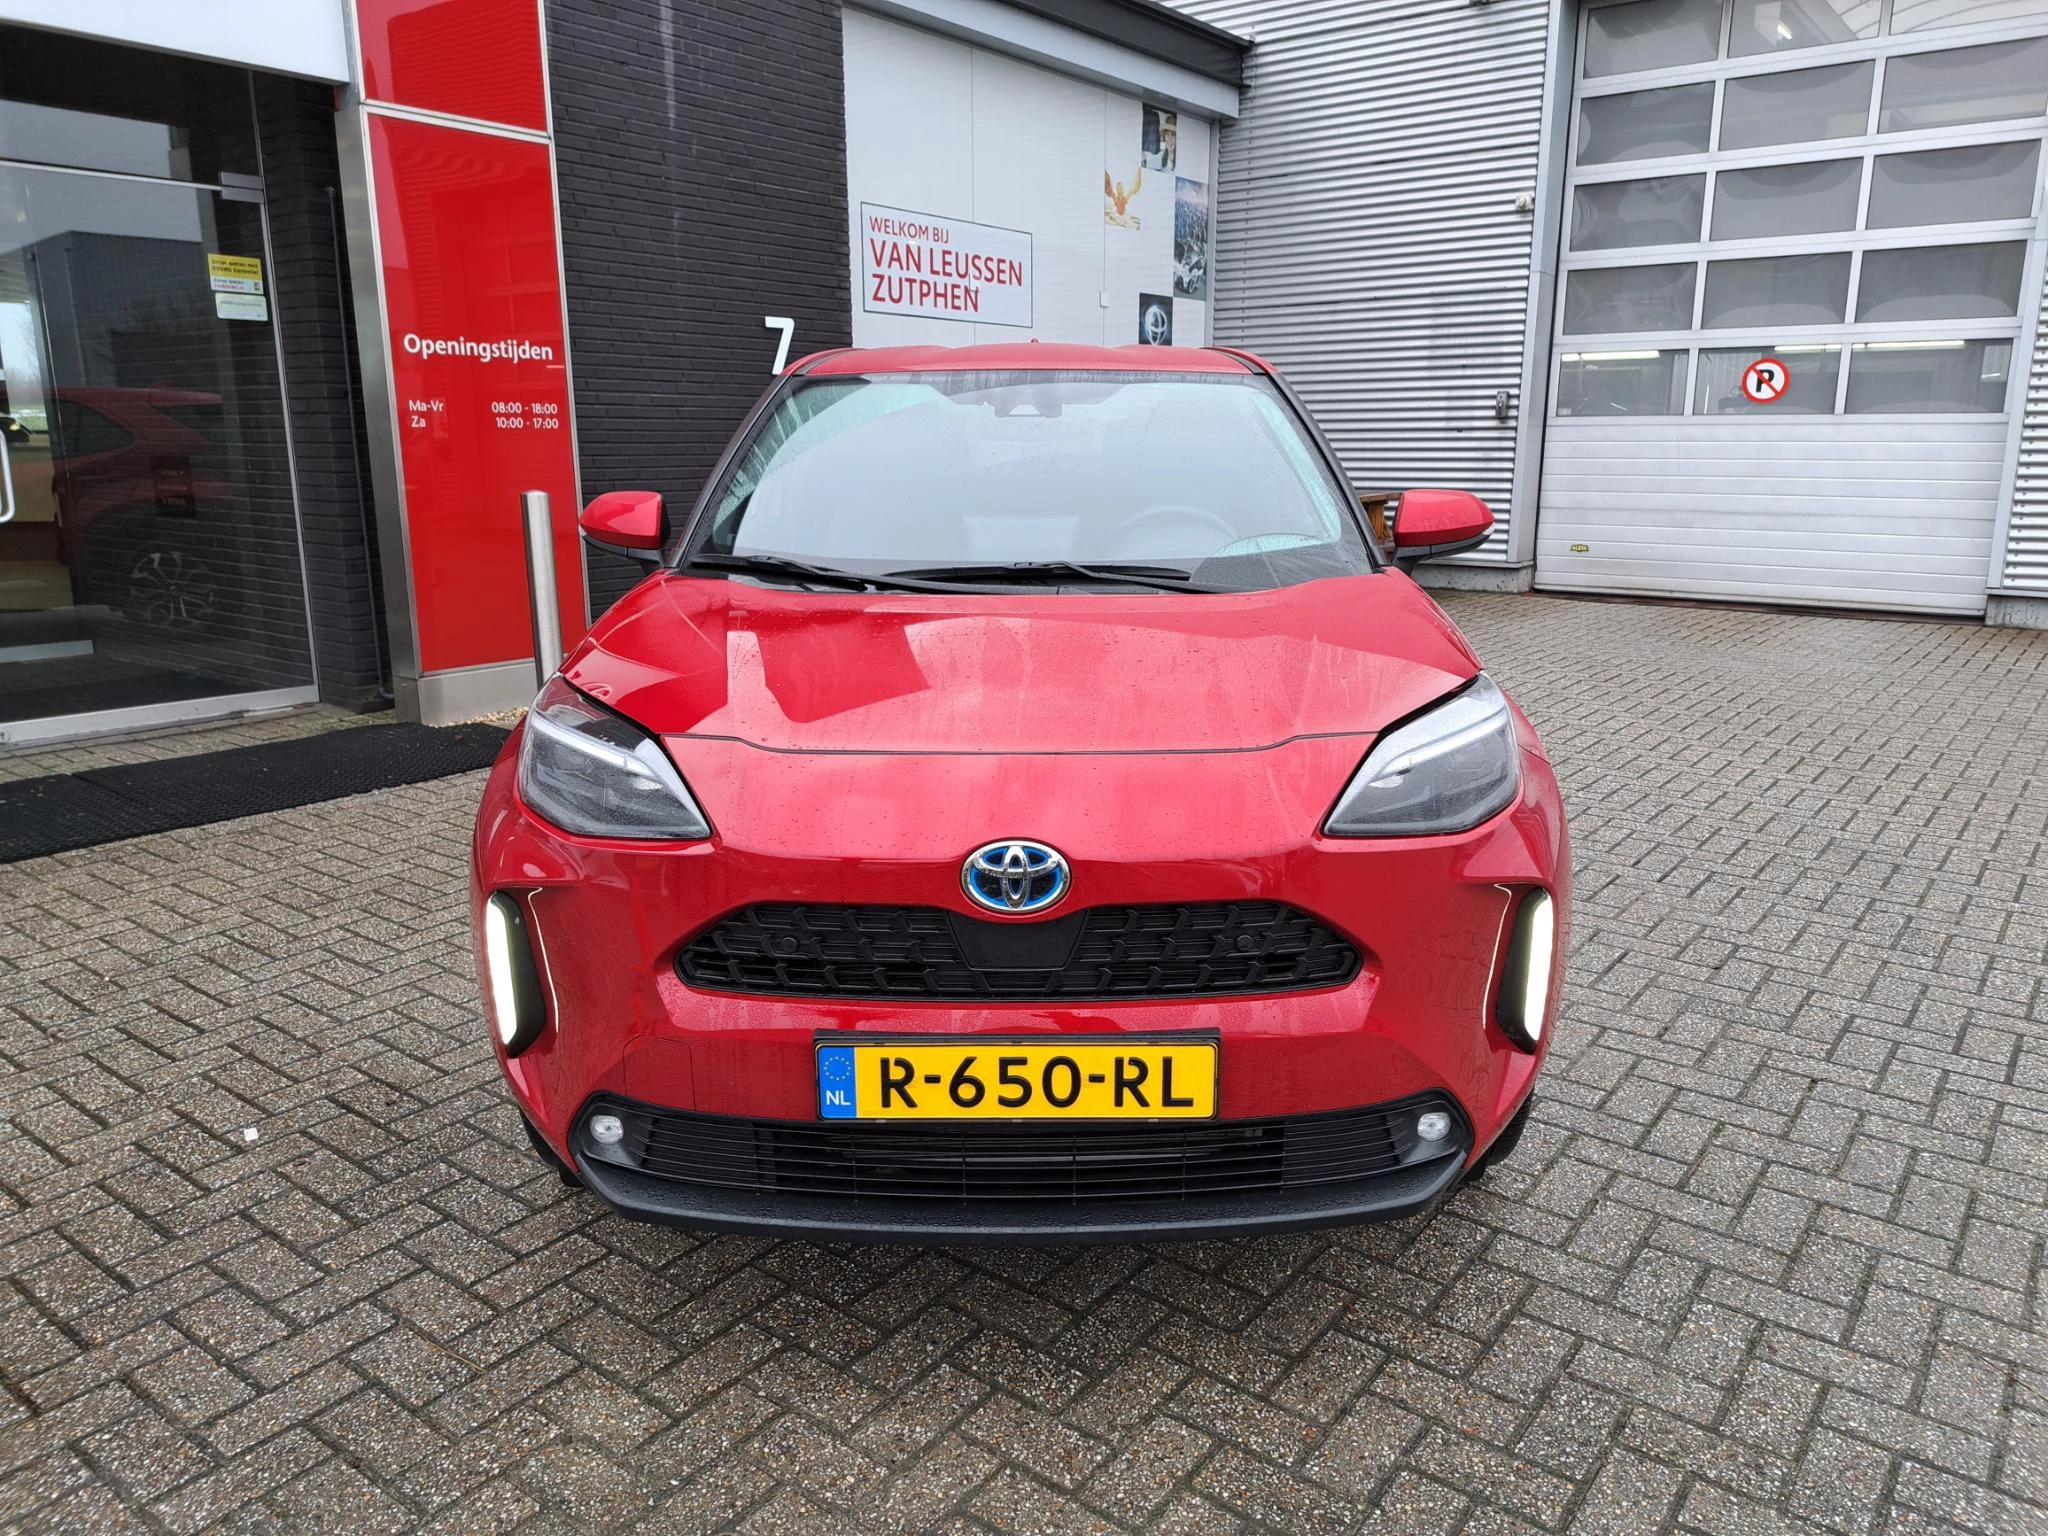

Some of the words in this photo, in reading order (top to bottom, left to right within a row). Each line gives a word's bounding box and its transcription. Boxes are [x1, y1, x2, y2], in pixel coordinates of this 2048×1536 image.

[869, 215, 929, 241] WELKOM
[932, 227, 949, 244] BIJ
[870, 238, 922, 273] VAN
[929, 247, 1023, 287] LEUSSEN
[871, 273, 980, 313] ZUTPHEN
[403, 333, 553, 364] Openingstijden
[765, 316, 795, 375] 7
[1755, 369, 1775, 393] P
[408, 399, 444, 412] Ma-Vr
[491, 401, 522, 414] 08:00
[531, 403, 558, 415] 18:00
[411, 415, 426, 428] Za
[496, 416, 524, 429] 10:00
[533, 417, 559, 429] 17:00
[880, 1055, 1194, 1109] R-650-RL
[826, 1089, 851, 1107] NL
